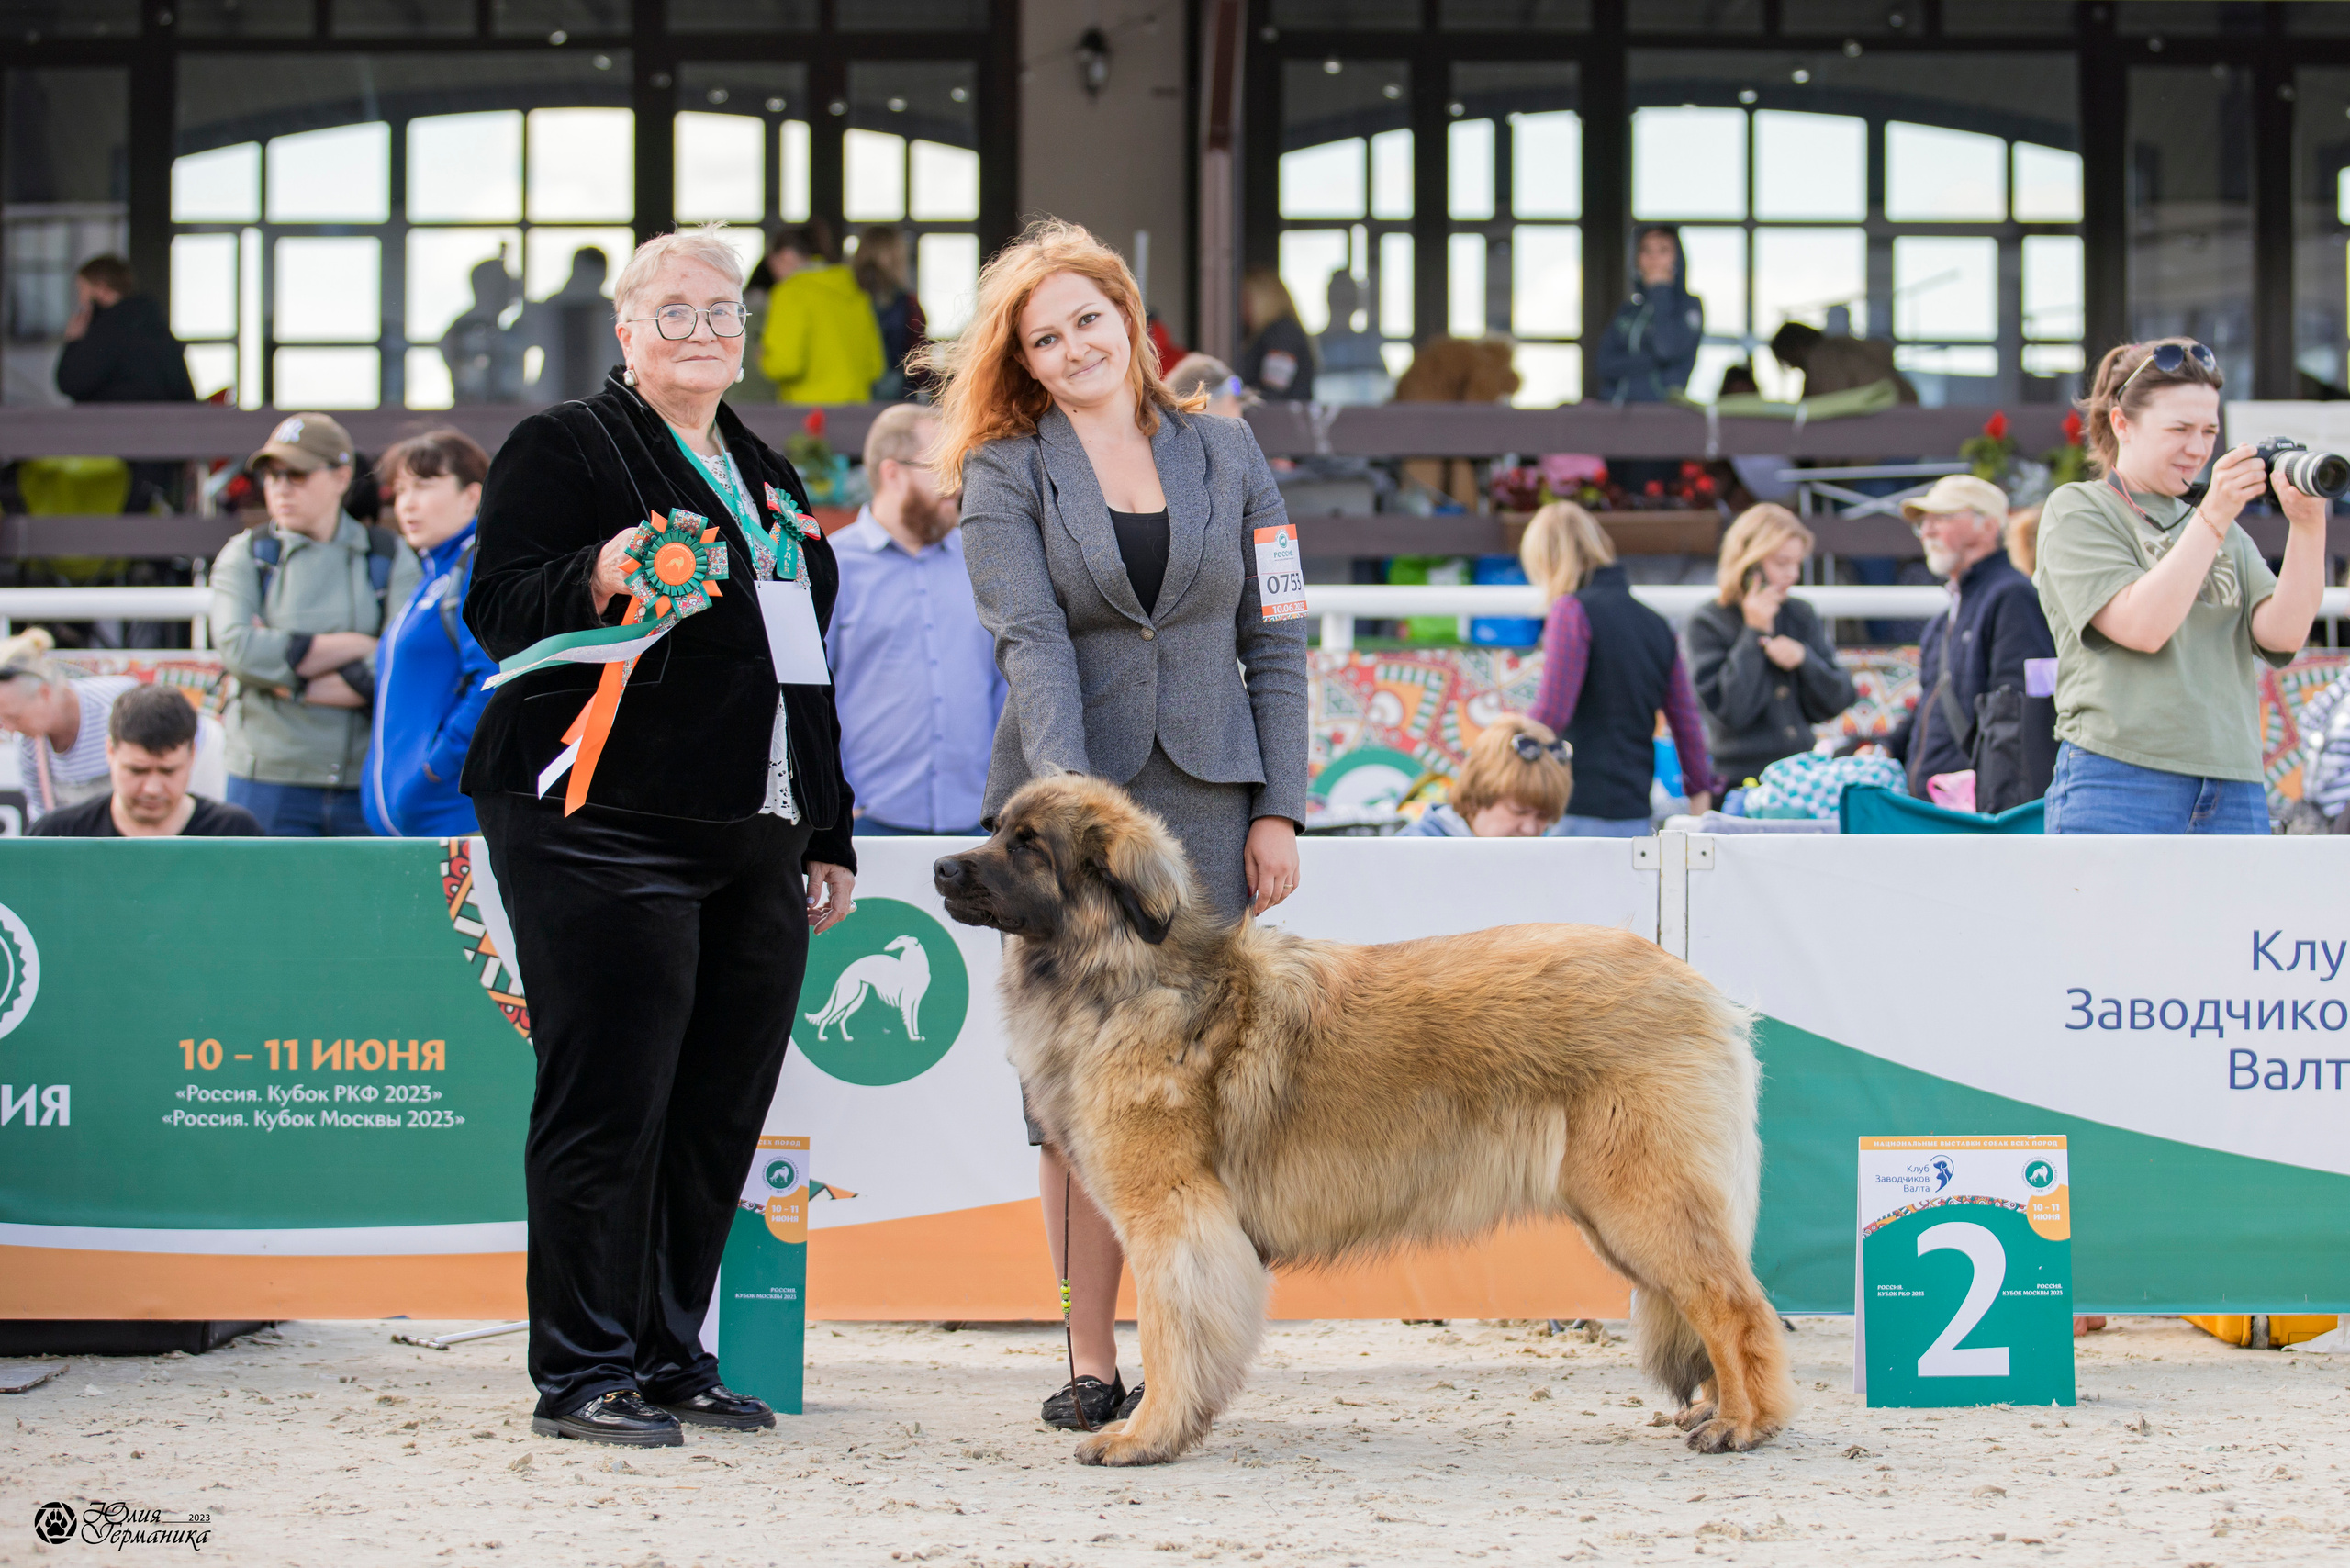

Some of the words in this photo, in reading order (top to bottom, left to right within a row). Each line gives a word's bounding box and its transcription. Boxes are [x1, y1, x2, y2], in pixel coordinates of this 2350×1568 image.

[1267, 572, 1302, 595] 0753
[179, 1038, 224, 1071] 10
[264, 1038, 299, 1071] 11
[311, 1038, 446, 1071] ИЮНЯ
[175, 1084, 263, 1103] «Россия.
[267, 1084, 330, 1107] Кубок
[334, 1084, 380, 1103] РКФ
[384, 1084, 443, 1103] 2023»
[162, 1109, 249, 1128] «Россия.
[253, 1110, 316, 1132] Кубок
[321, 1110, 402, 1128] Москвы
[406, 1110, 466, 1128] 2023»
[1874, 1174, 1930, 1183] Заводчиков
[1907, 1164, 1930, 1173] Клуб
[1903, 1184, 1930, 1193] Валта
[771, 1204, 782, 1213] 10
[1917, 1221, 2010, 1377] 2
